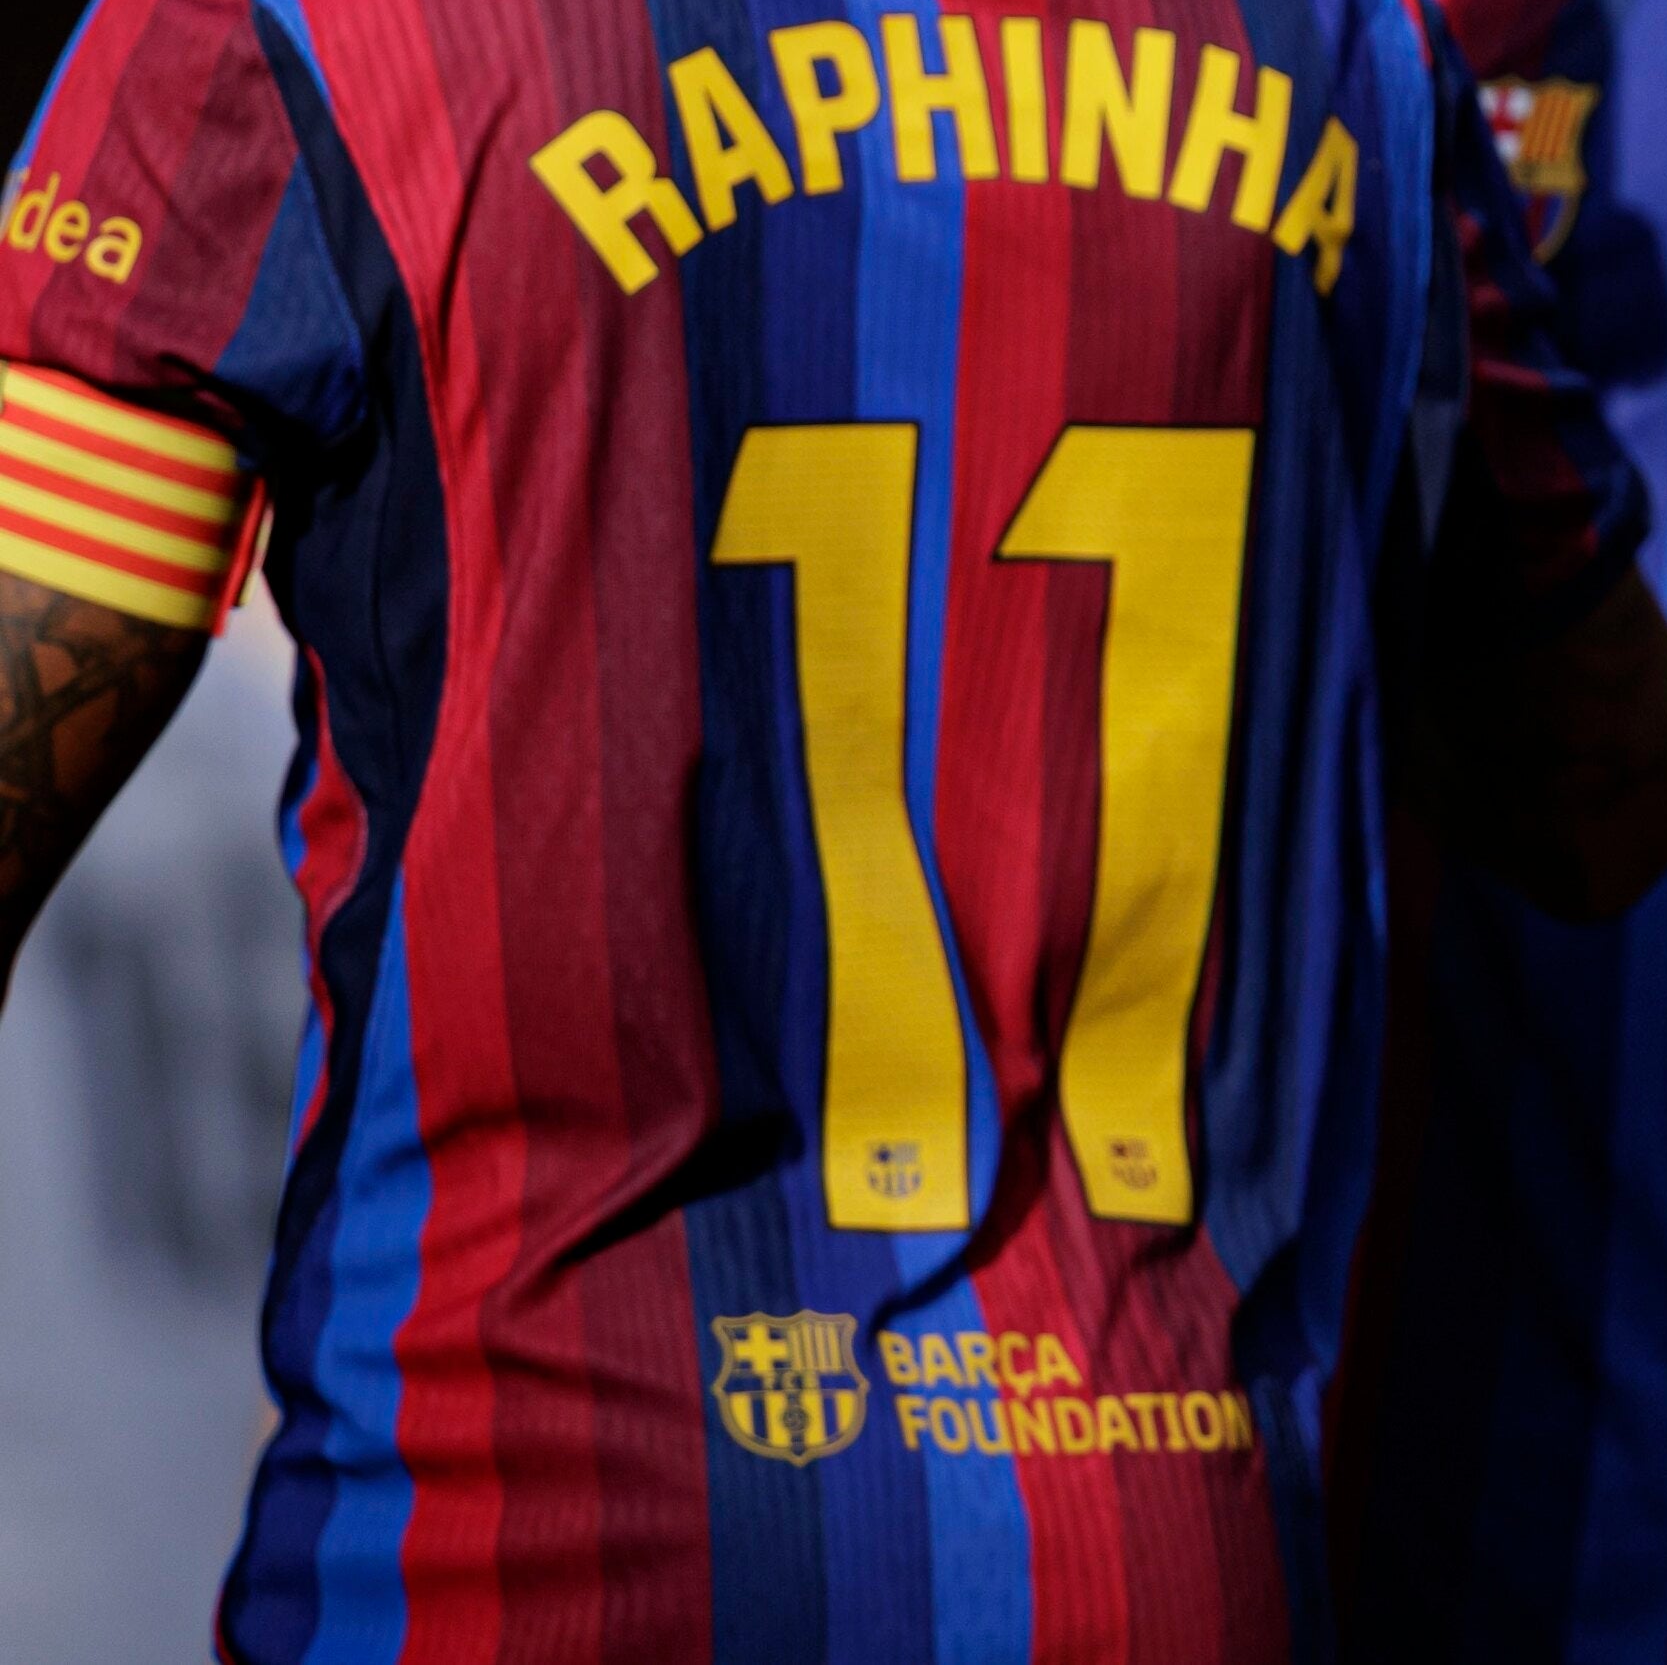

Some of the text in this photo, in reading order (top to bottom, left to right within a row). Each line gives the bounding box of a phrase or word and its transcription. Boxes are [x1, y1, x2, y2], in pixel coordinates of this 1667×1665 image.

[529, 12, 1360, 298] RAPHINHA
[0, 167, 143, 286] idea
[710, 422, 1256, 1231] 11
[877, 1330, 1083, 1396] BARÇA
[893, 1389, 1256, 1456] FOUNDATION
